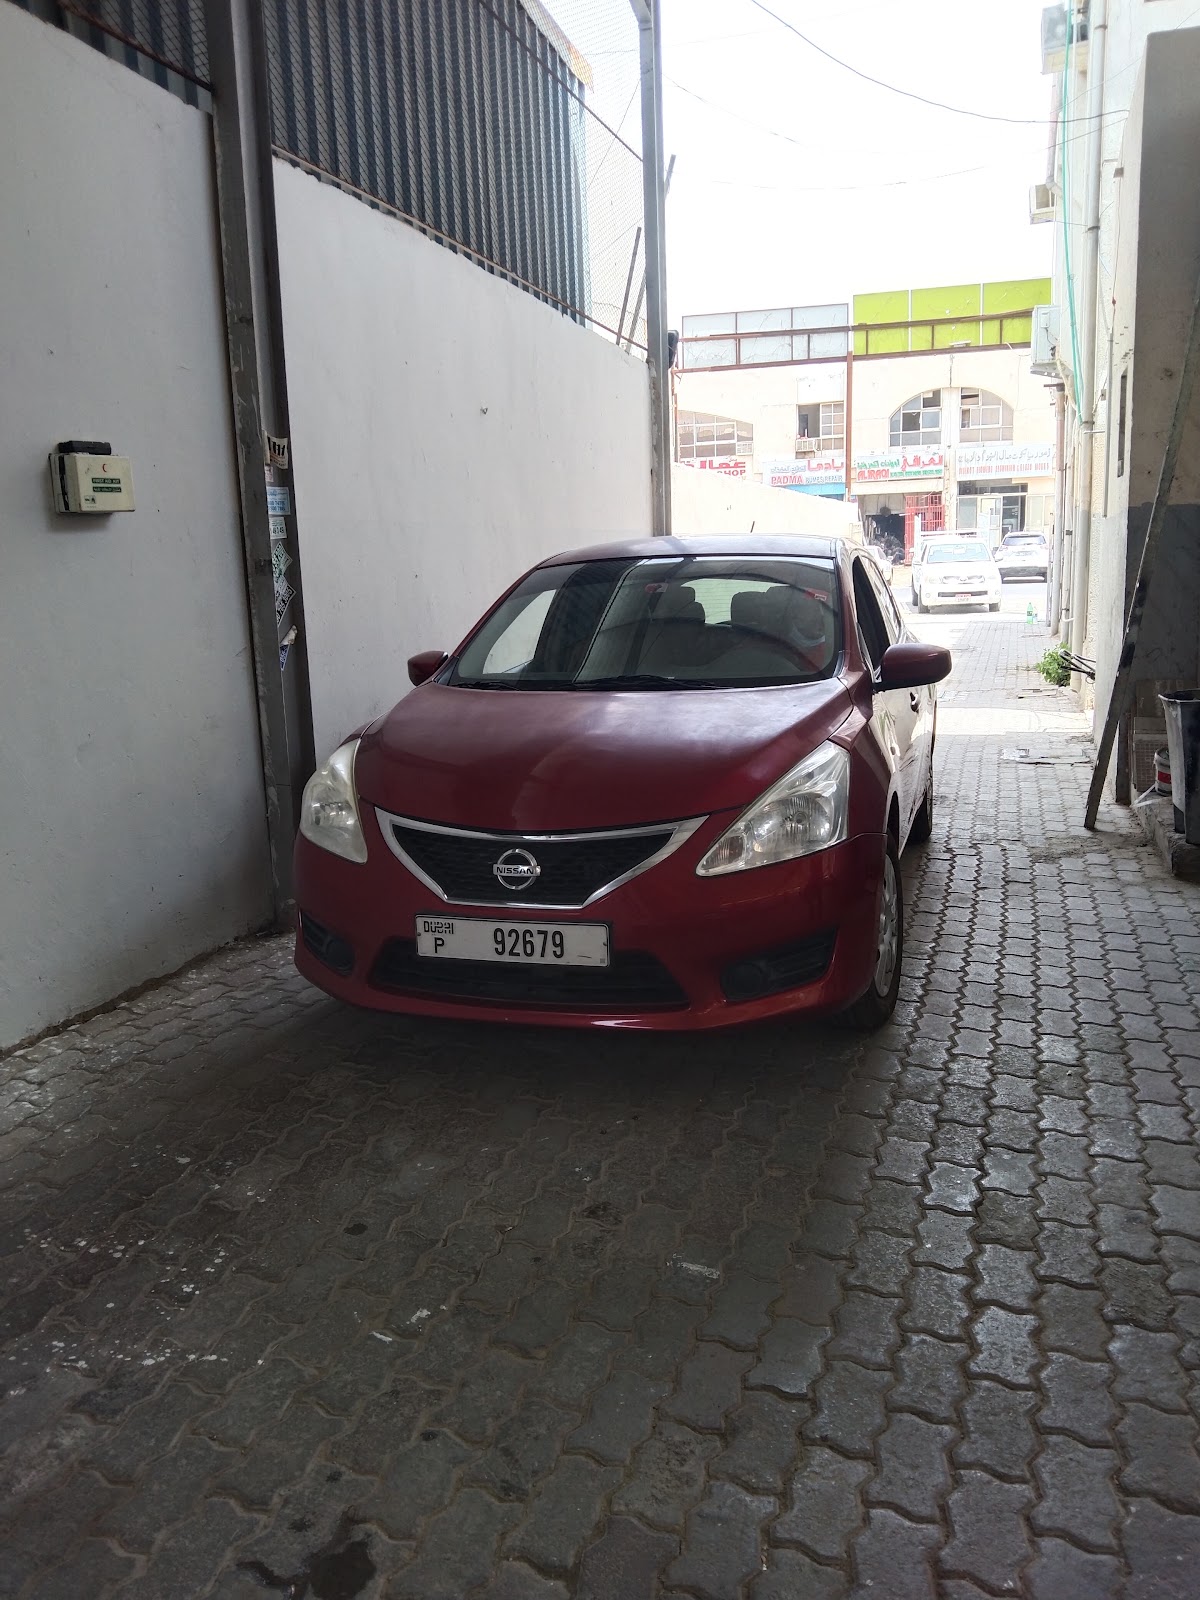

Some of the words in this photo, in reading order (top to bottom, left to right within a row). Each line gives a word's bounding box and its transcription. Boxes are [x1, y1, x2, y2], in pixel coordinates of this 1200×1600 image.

[771, 475, 803, 484] PADMA
[496, 866, 534, 875] NISSAN
[434, 937, 444, 953] P
[493, 928, 565, 958] 92679
